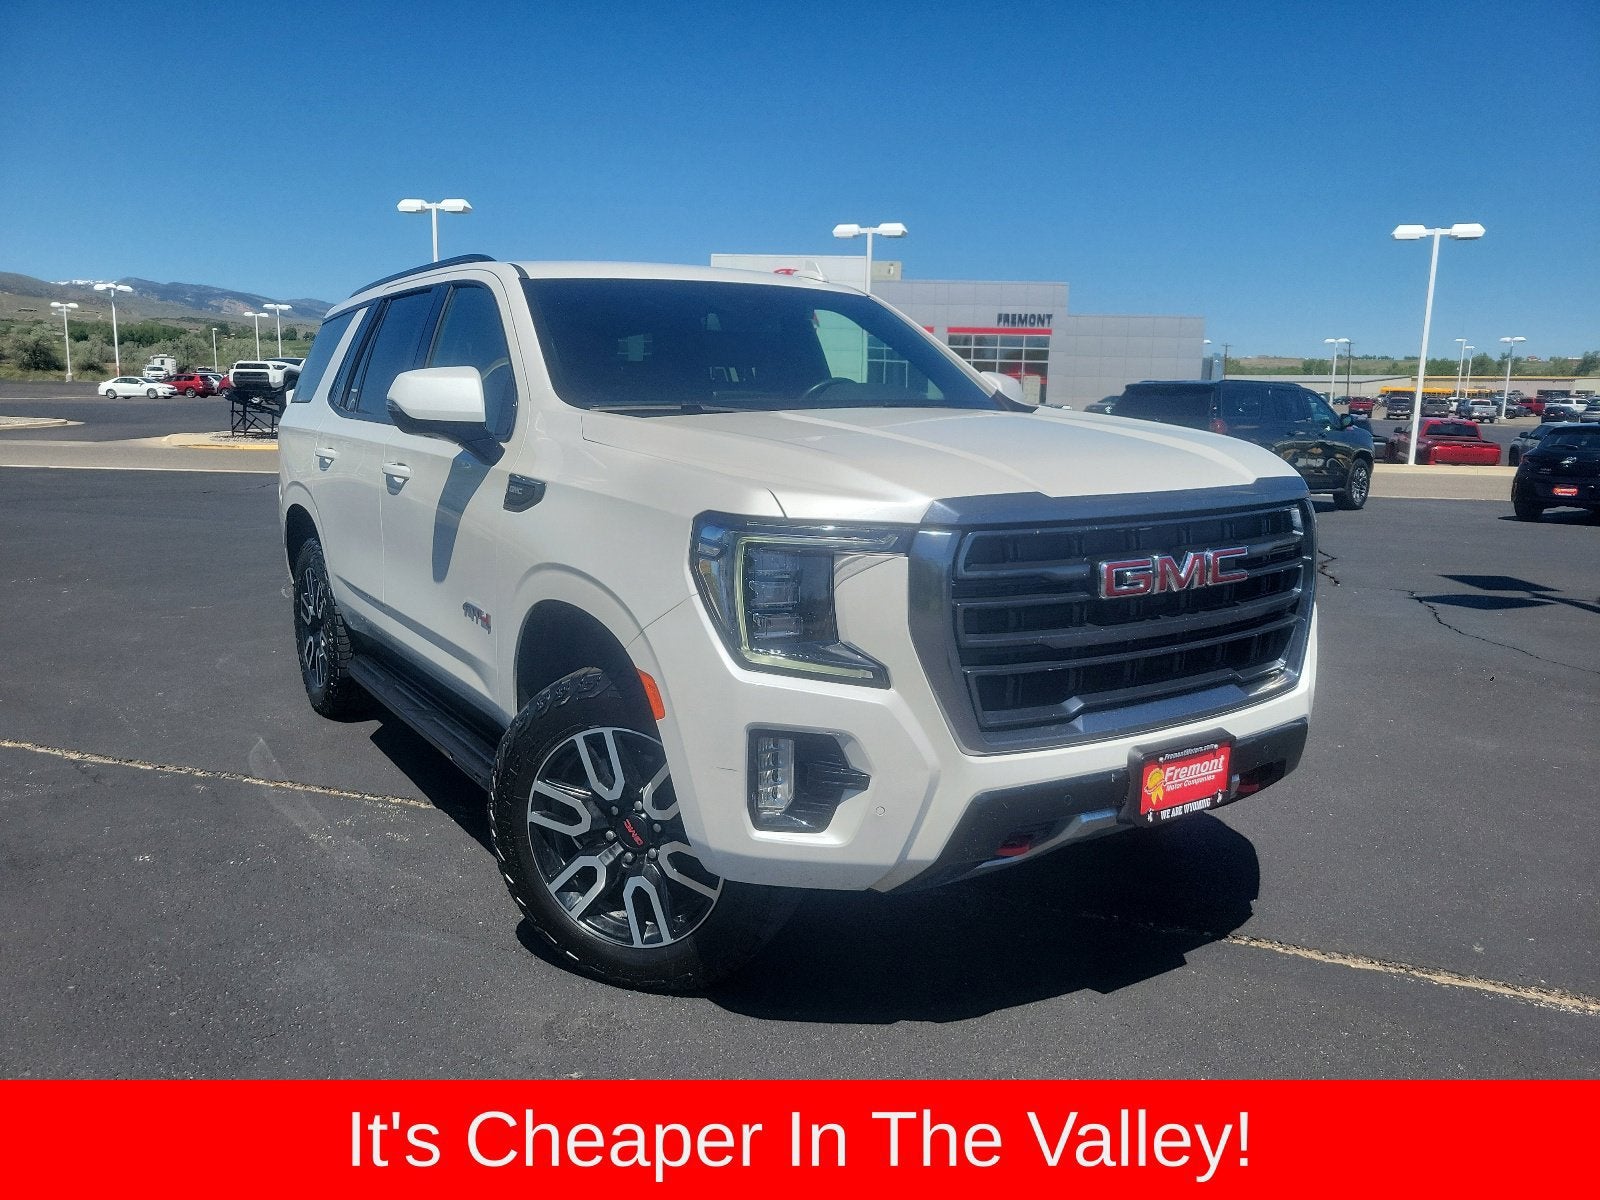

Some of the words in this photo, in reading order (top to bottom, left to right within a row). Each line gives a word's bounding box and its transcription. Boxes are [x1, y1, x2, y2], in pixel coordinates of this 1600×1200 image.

[997, 313, 1053, 328] FREMONT
[1098, 545, 1249, 600] GMC
[1164, 754, 1225, 782] Fremont
[1166, 782, 1182, 792] Motor
[1183, 775, 1215, 787] Companies
[1160, 809, 1171, 821] WE
[1170, 805, 1183, 818] ARE
[1183, 797, 1211, 814] WYOMING
